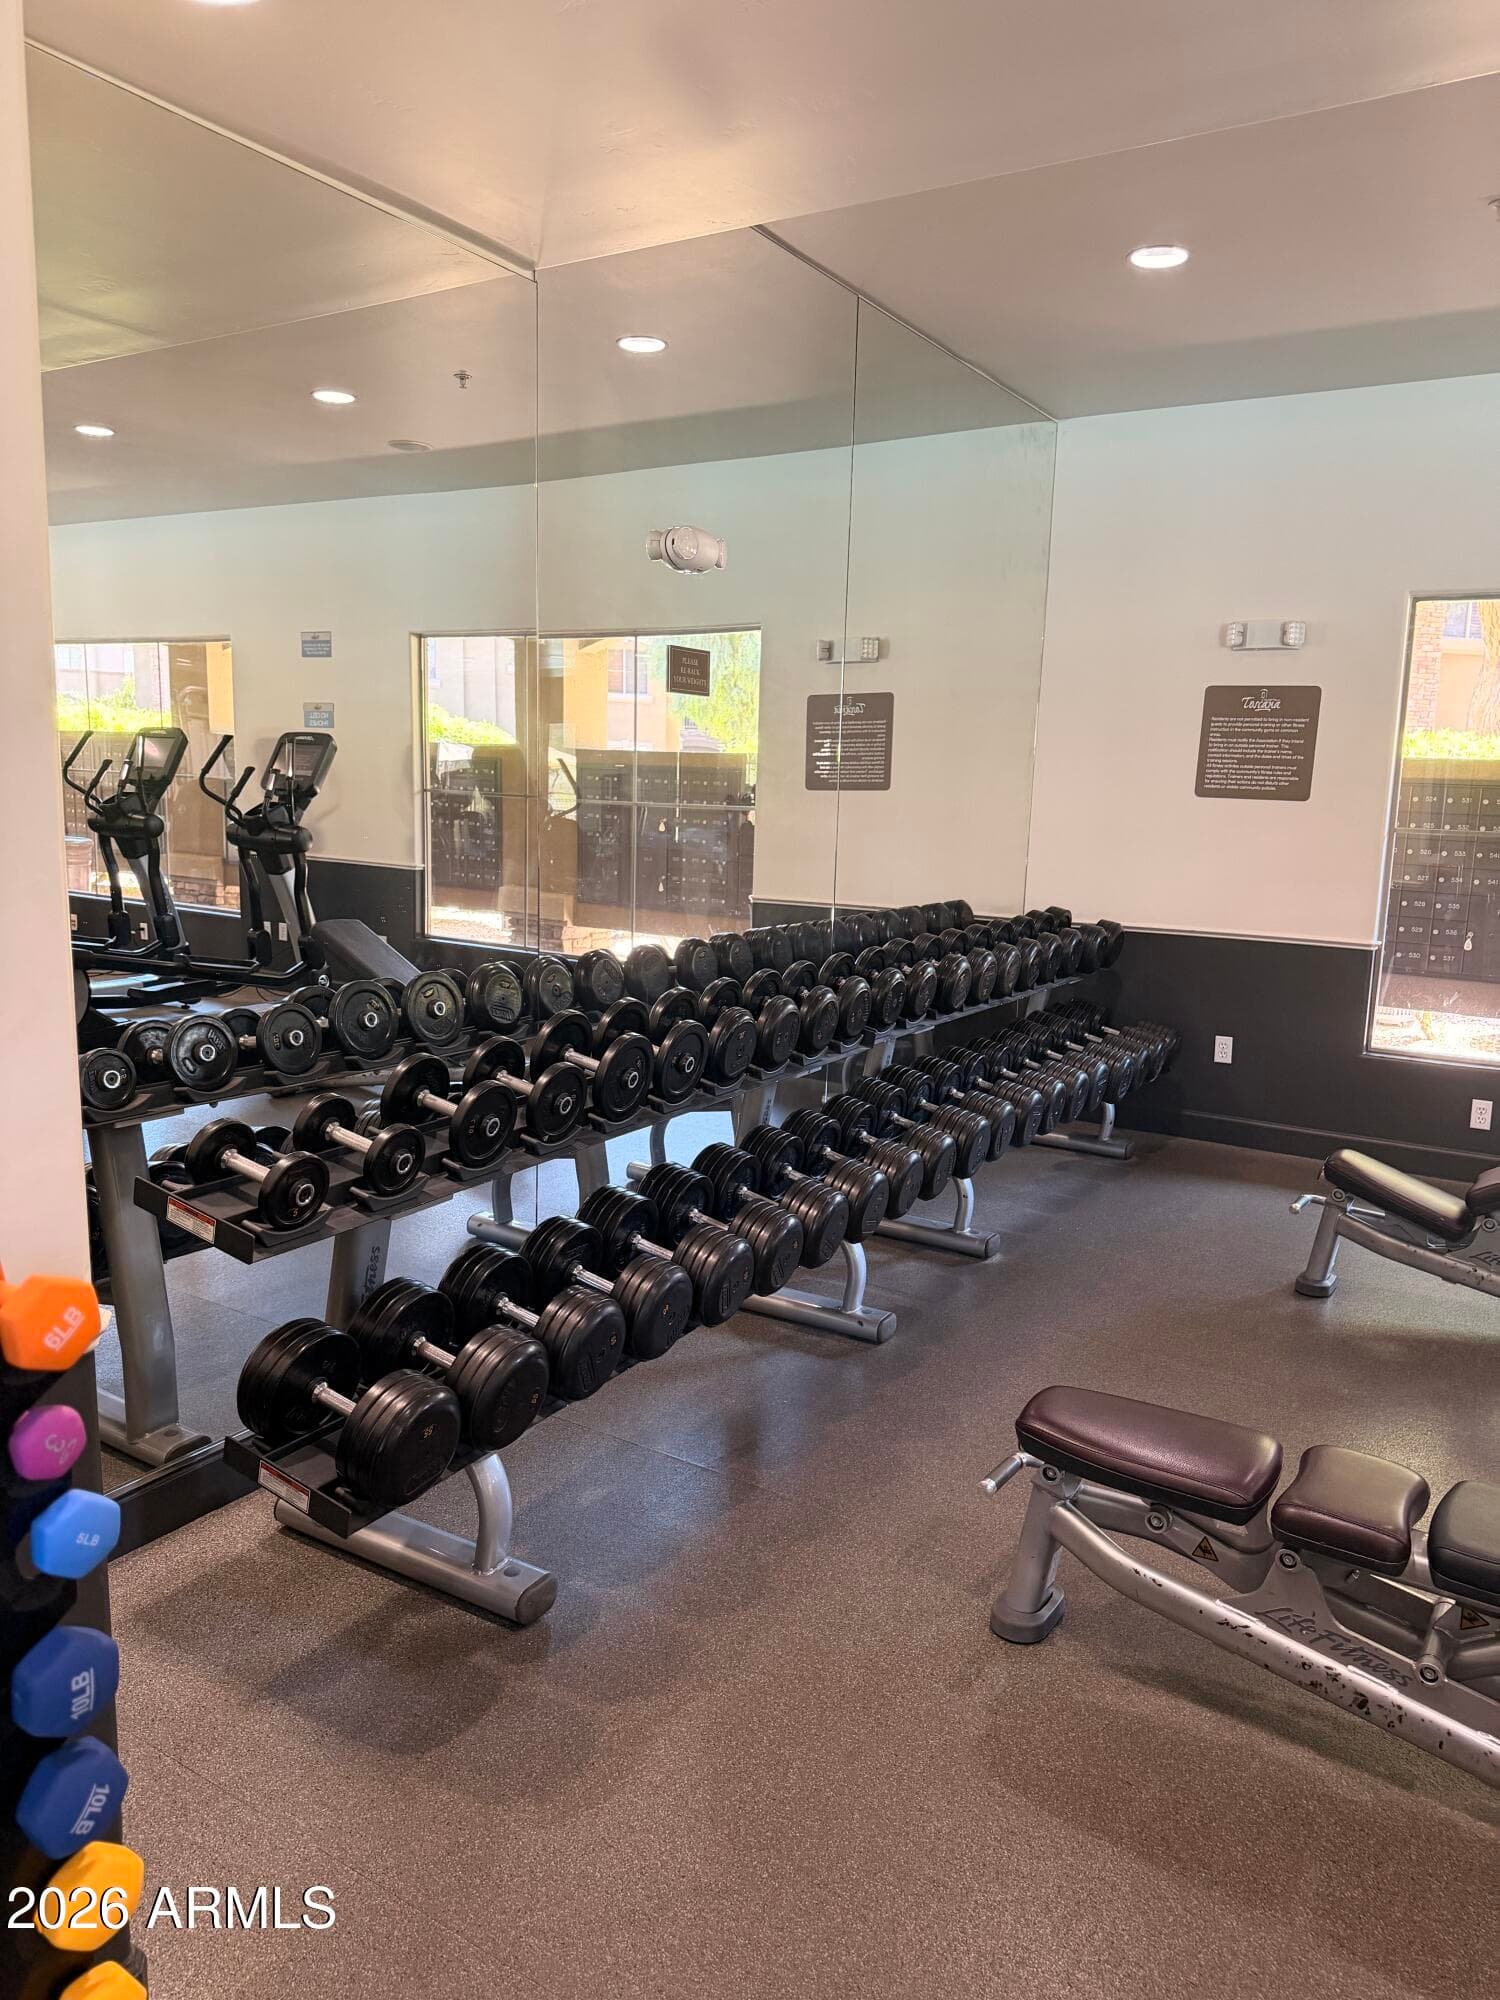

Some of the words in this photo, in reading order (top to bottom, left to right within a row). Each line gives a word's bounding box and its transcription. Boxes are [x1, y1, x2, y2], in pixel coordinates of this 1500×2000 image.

[1242, 696, 1280, 709] Toscana
[44, 1306, 83, 1351] 6LB
[76, 1532, 100, 1546] 5LB
[1254, 1607, 1317, 1634] Life
[1309, 1630, 1414, 1687] Fitness
[70, 1668, 93, 1720] 10LB
[72, 1784, 110, 1834] 10LB
